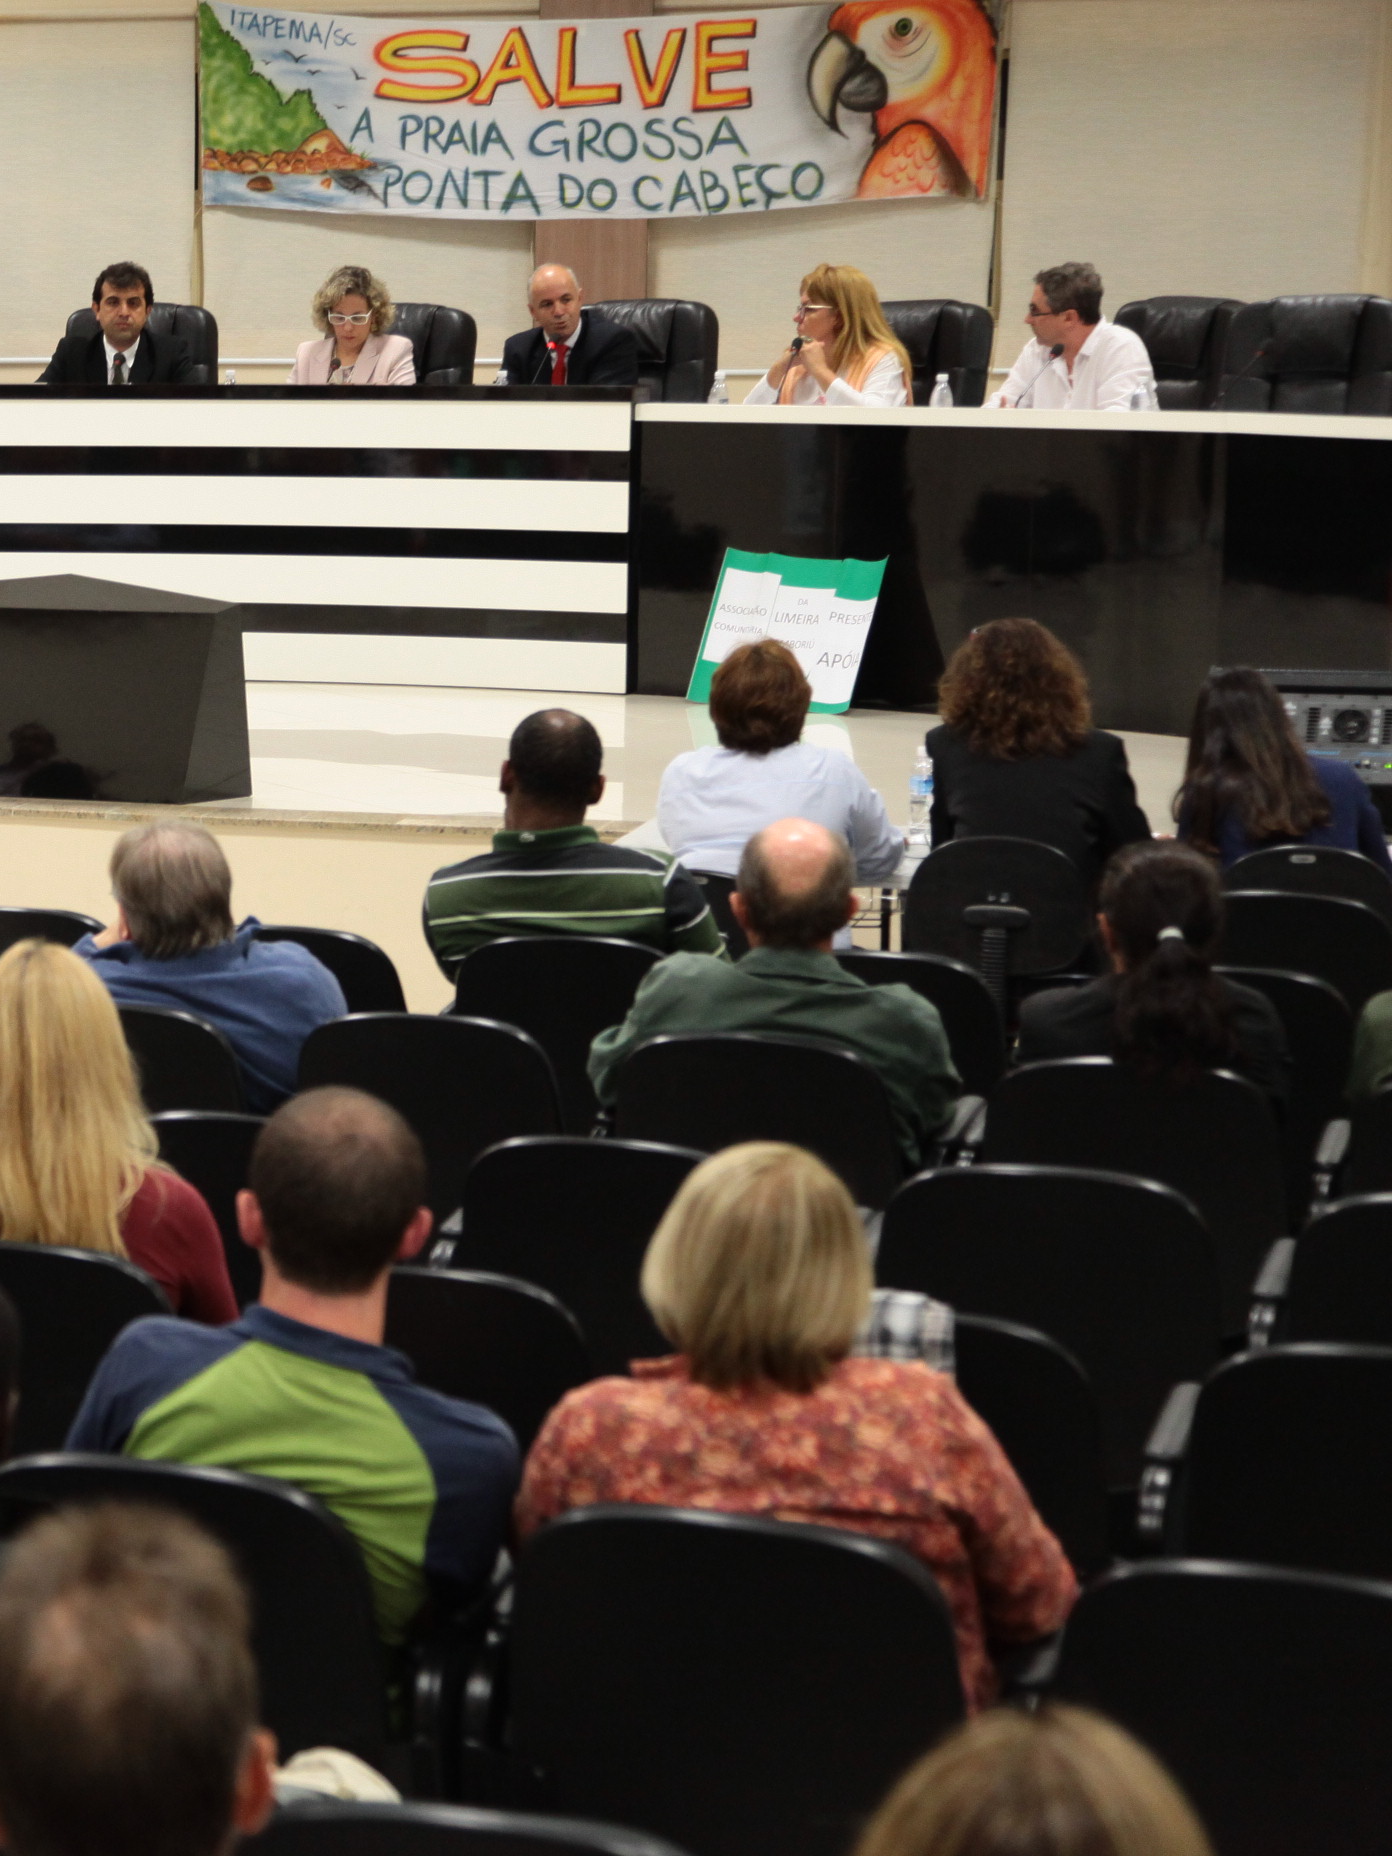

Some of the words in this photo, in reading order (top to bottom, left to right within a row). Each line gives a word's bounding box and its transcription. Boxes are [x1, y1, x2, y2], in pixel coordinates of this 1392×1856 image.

[372, 18, 757, 113] SALVE
[349, 106, 375, 144] A
[398, 114, 515, 161] PRAIA
[528, 116, 750, 163] GROSSA
[381, 163, 541, 217] PONTA
[558, 173, 618, 212] DO
[631, 161, 825, 216] CABEÇO
[774, 611, 821, 625] LIMEIRA
[797, 598, 810, 607] DA
